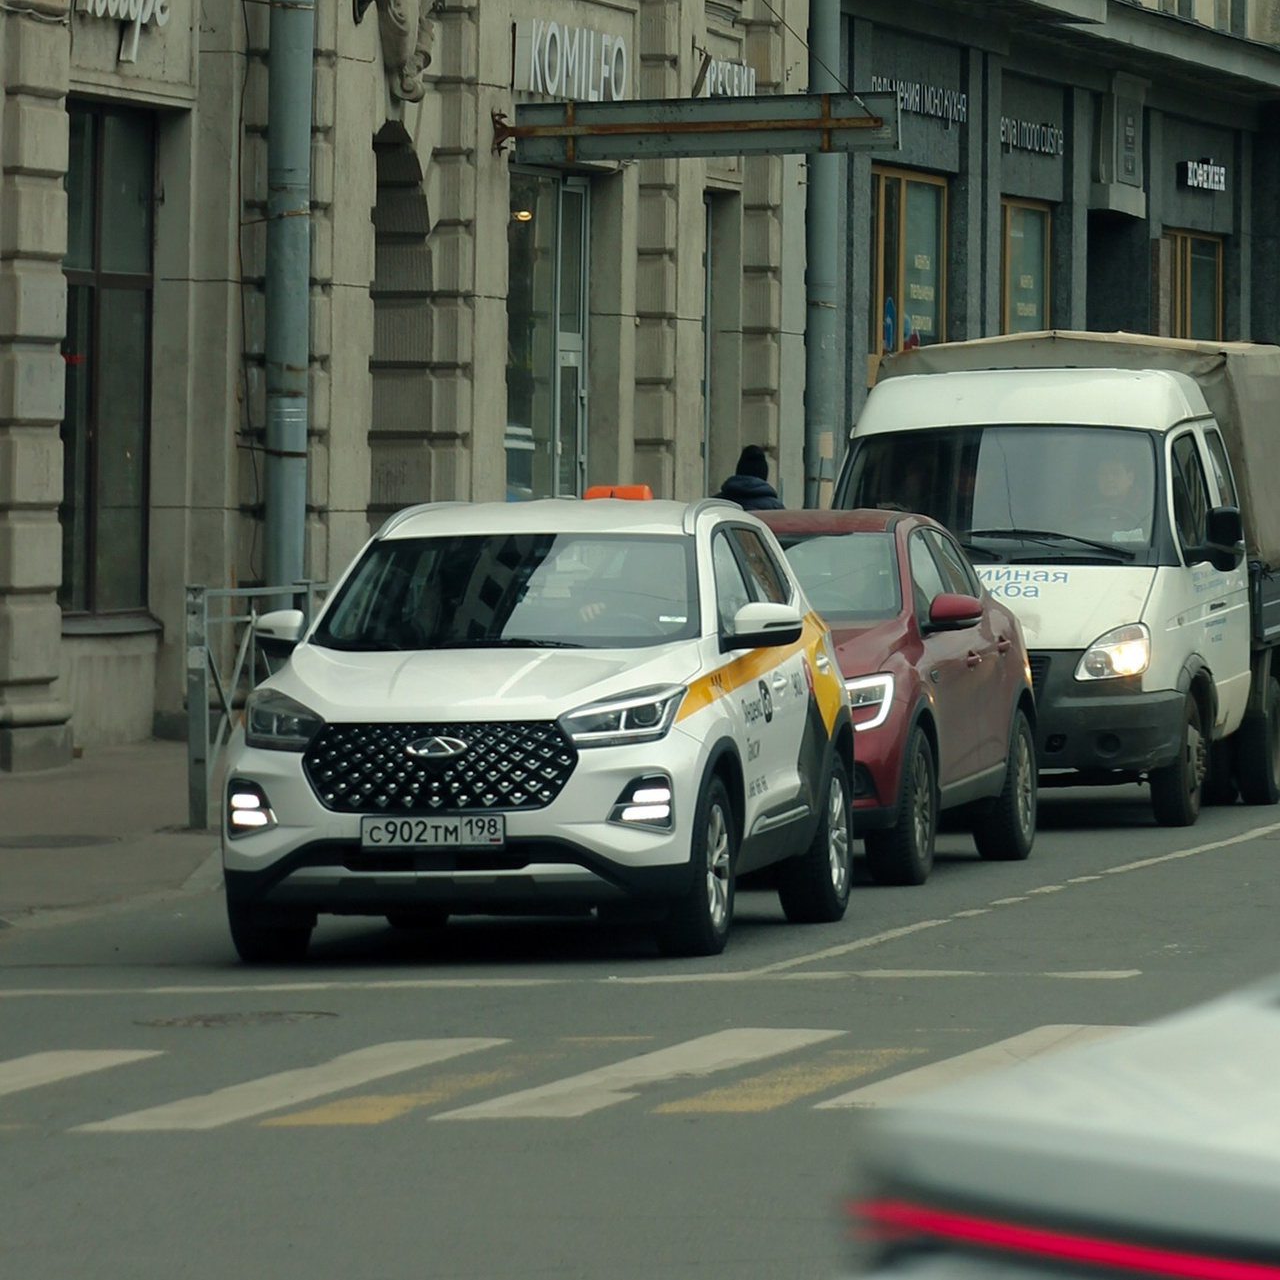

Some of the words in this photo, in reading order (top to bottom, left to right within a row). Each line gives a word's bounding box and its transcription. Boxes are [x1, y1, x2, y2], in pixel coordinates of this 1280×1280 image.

[530, 18, 627, 102] KOMILFO
[1187, 158, 1226, 191] КОФЕЙНЯ
[464, 818, 498, 836] 198
